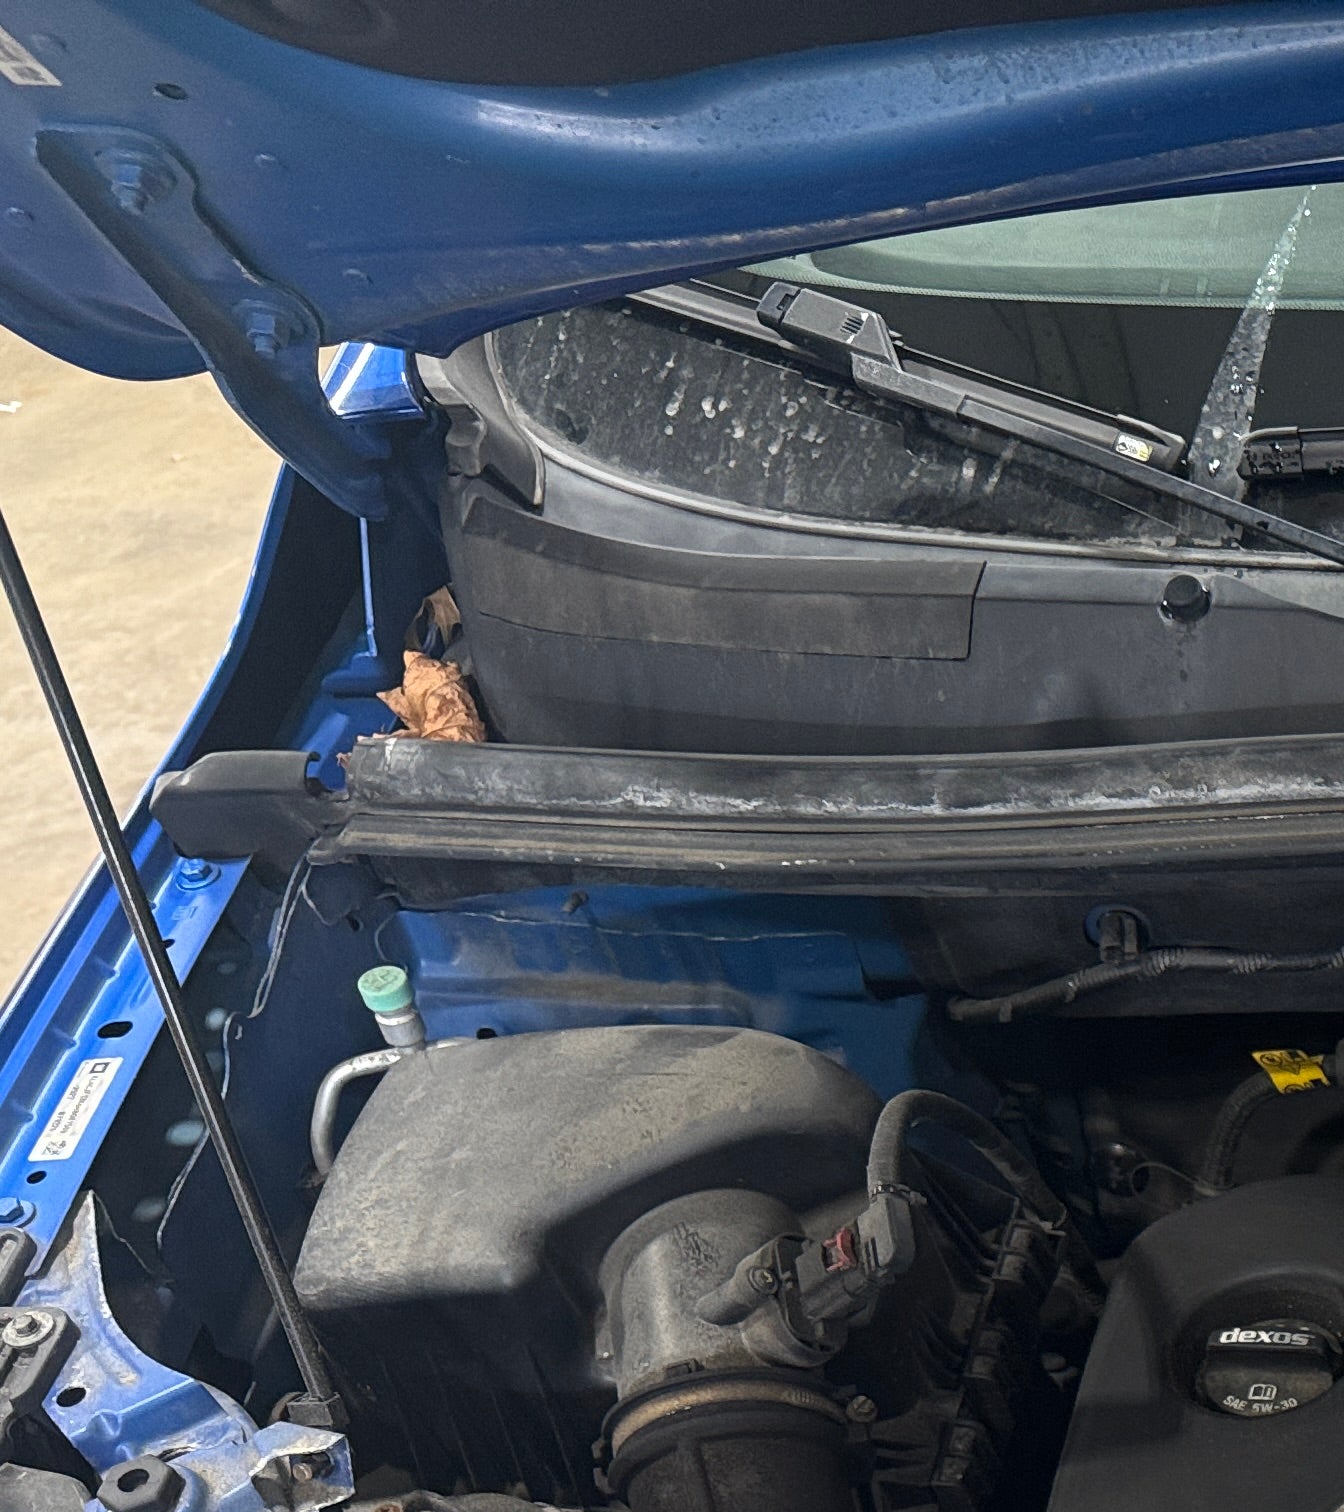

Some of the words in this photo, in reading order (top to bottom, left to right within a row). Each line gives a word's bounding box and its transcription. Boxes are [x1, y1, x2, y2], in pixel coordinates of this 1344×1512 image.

[1219, 1327, 1316, 1346] dexos
[1223, 1396, 1248, 1411] SAE
[1251, 1397, 1299, 1413] 5W-30
